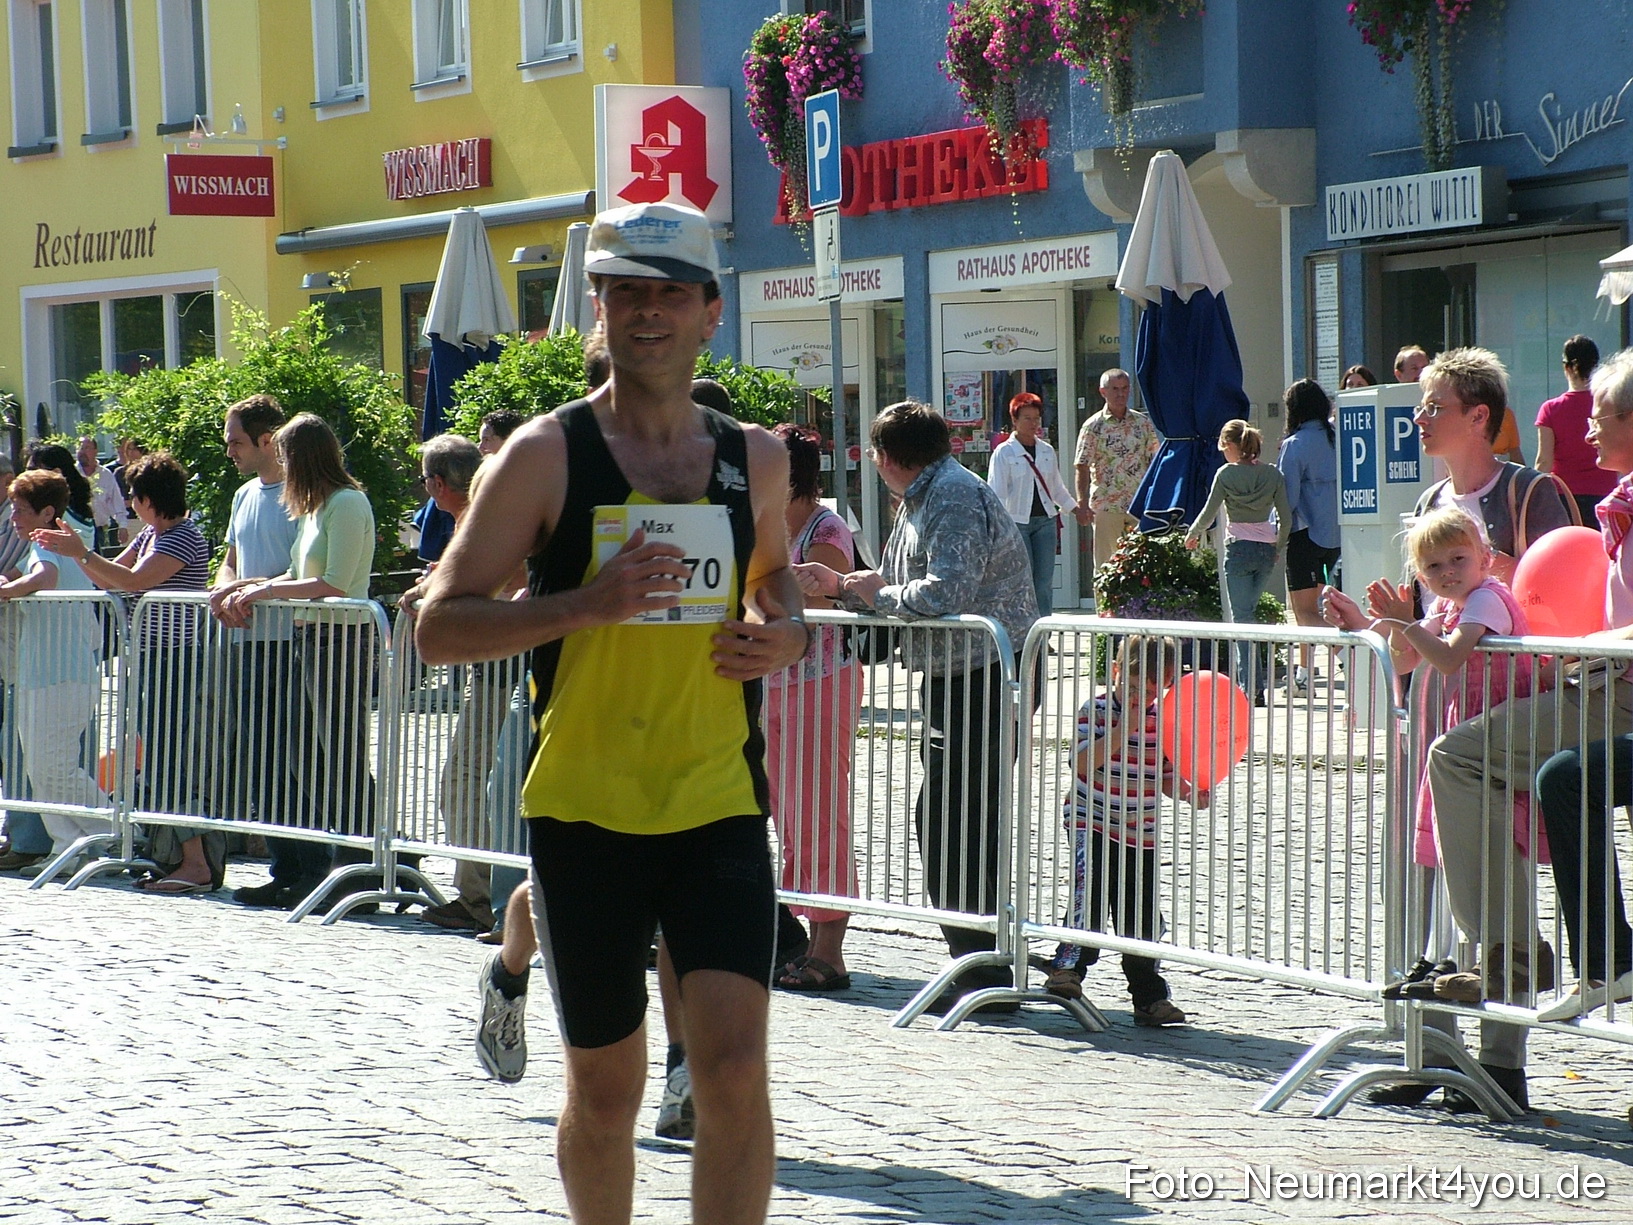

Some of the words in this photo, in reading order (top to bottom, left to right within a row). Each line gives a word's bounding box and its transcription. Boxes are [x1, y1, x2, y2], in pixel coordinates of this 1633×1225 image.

[1474, 99, 1503, 141] DER
[382, 137, 480, 200] WISSMACH
[813, 109, 831, 192] P
[173, 175, 270, 197] WISSMACH
[772, 118, 1049, 225] OTHEKE
[1329, 182, 1421, 235] KONDITOREI
[1431, 175, 1478, 223] WITTL
[33, 217, 157, 269] Restaurant
[957, 253, 1016, 282] RATHAUS
[1021, 245, 1091, 275] APOTHEKE
[763, 276, 815, 301] RATHAUS
[772, 346, 790, 356] Haus
[791, 343, 803, 351] der
[963, 328, 983, 340] Haus
[983, 325, 996, 334] der
[997, 325, 1039, 338] Gesundheit
[1343, 411, 1372, 431] HIER
[1393, 416, 1414, 452] P
[1351, 436, 1367, 483] P
[1388, 460, 1418, 479] SCHEINE
[1343, 488, 1376, 509] SCHEINE
[641, 519, 675, 534] Max
